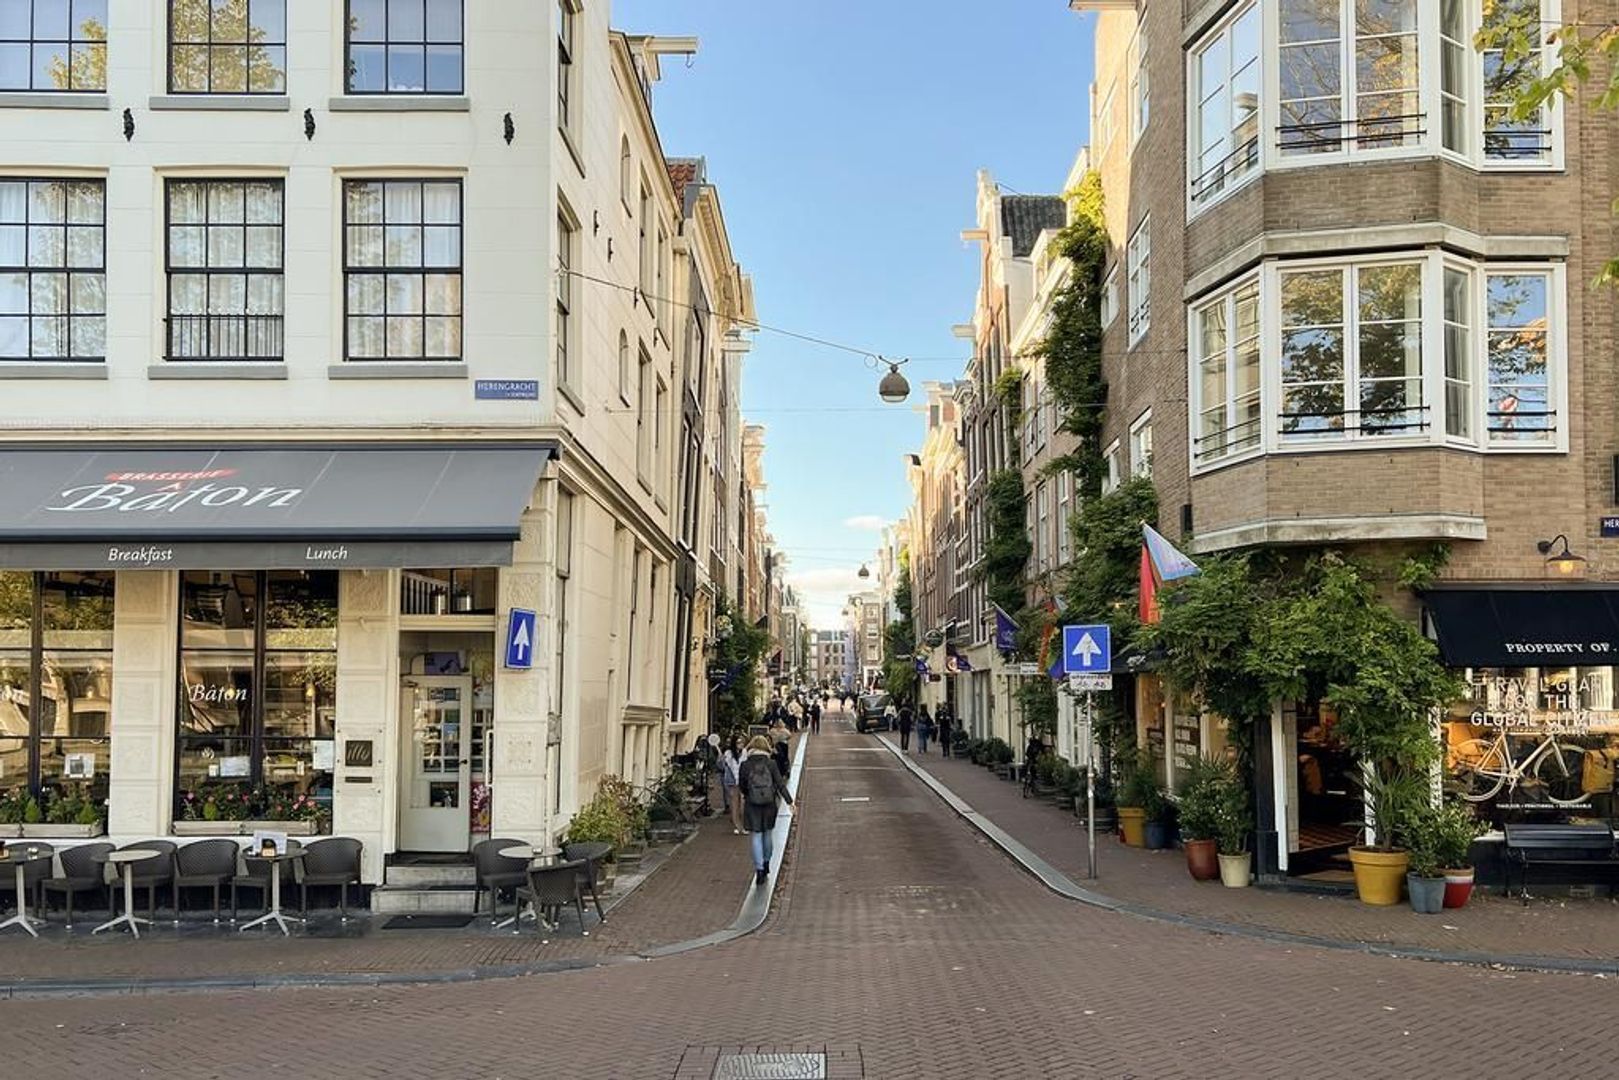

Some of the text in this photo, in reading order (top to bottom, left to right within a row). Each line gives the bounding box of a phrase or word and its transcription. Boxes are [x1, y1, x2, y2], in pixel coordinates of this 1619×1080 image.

[477, 382, 536, 391] HERENGRACHT
[46, 482, 303, 512] Bâton
[108, 546, 173, 566] Breakfast
[305, 545, 348, 560] Lunch
[1505, 643, 1583, 653] PROPERTY
[190, 684, 248, 701] Bâton
[1471, 711, 1539, 727] GLOBAL
